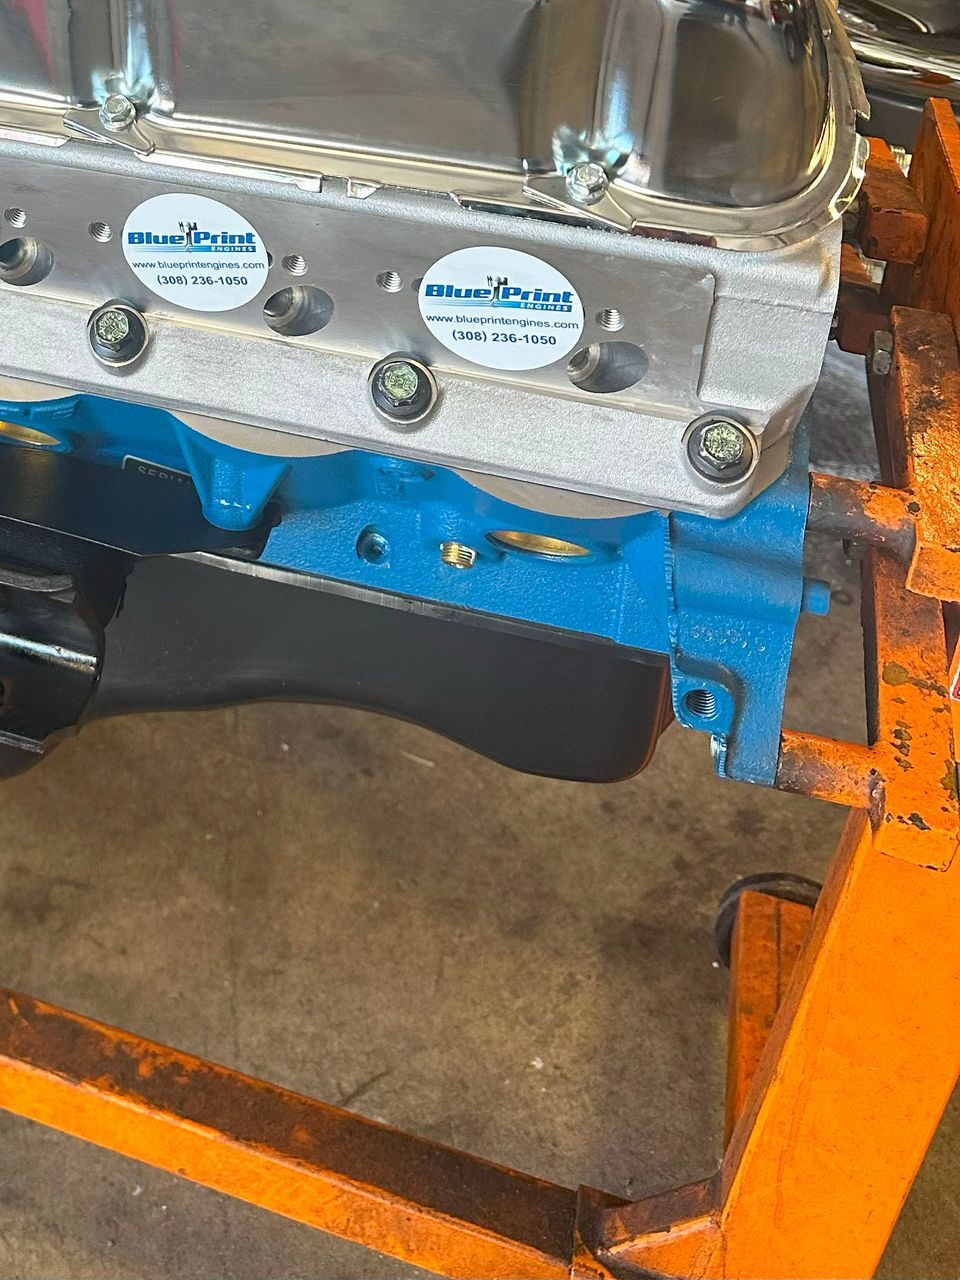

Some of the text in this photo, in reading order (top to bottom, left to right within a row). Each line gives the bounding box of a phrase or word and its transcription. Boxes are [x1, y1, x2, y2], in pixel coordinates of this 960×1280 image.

[132, 261, 265, 270] www.blueprintengines.com
[157, 274, 248, 286] (308) 236-1050
[520, 302, 569, 311] ENGINES
[426, 314, 579, 329] www.blueprintengines.com
[452, 329, 557, 345] (308) 236-1050
